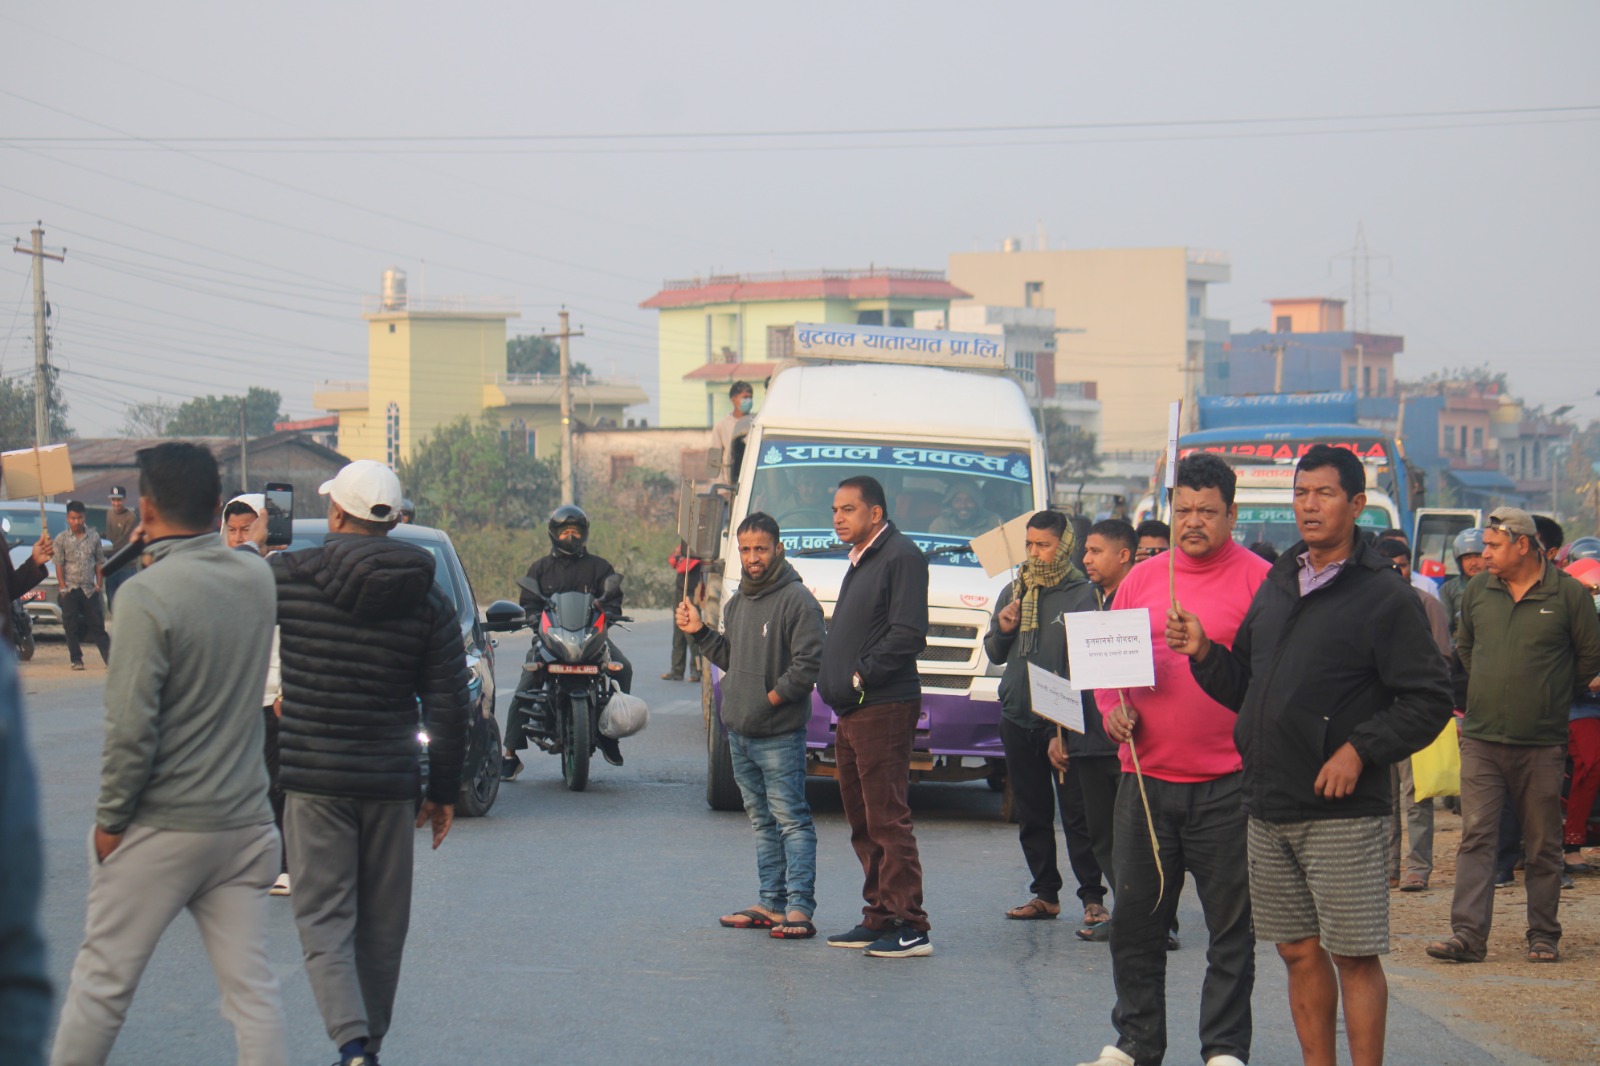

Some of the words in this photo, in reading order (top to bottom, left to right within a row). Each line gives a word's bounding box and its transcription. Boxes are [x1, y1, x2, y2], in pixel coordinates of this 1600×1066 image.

[798, 329, 855, 348] बुटवल
[863, 333, 941, 353] यातायात
[786, 446, 882, 460] रावल
[892, 447, 1008, 471] ट्रावल्स
